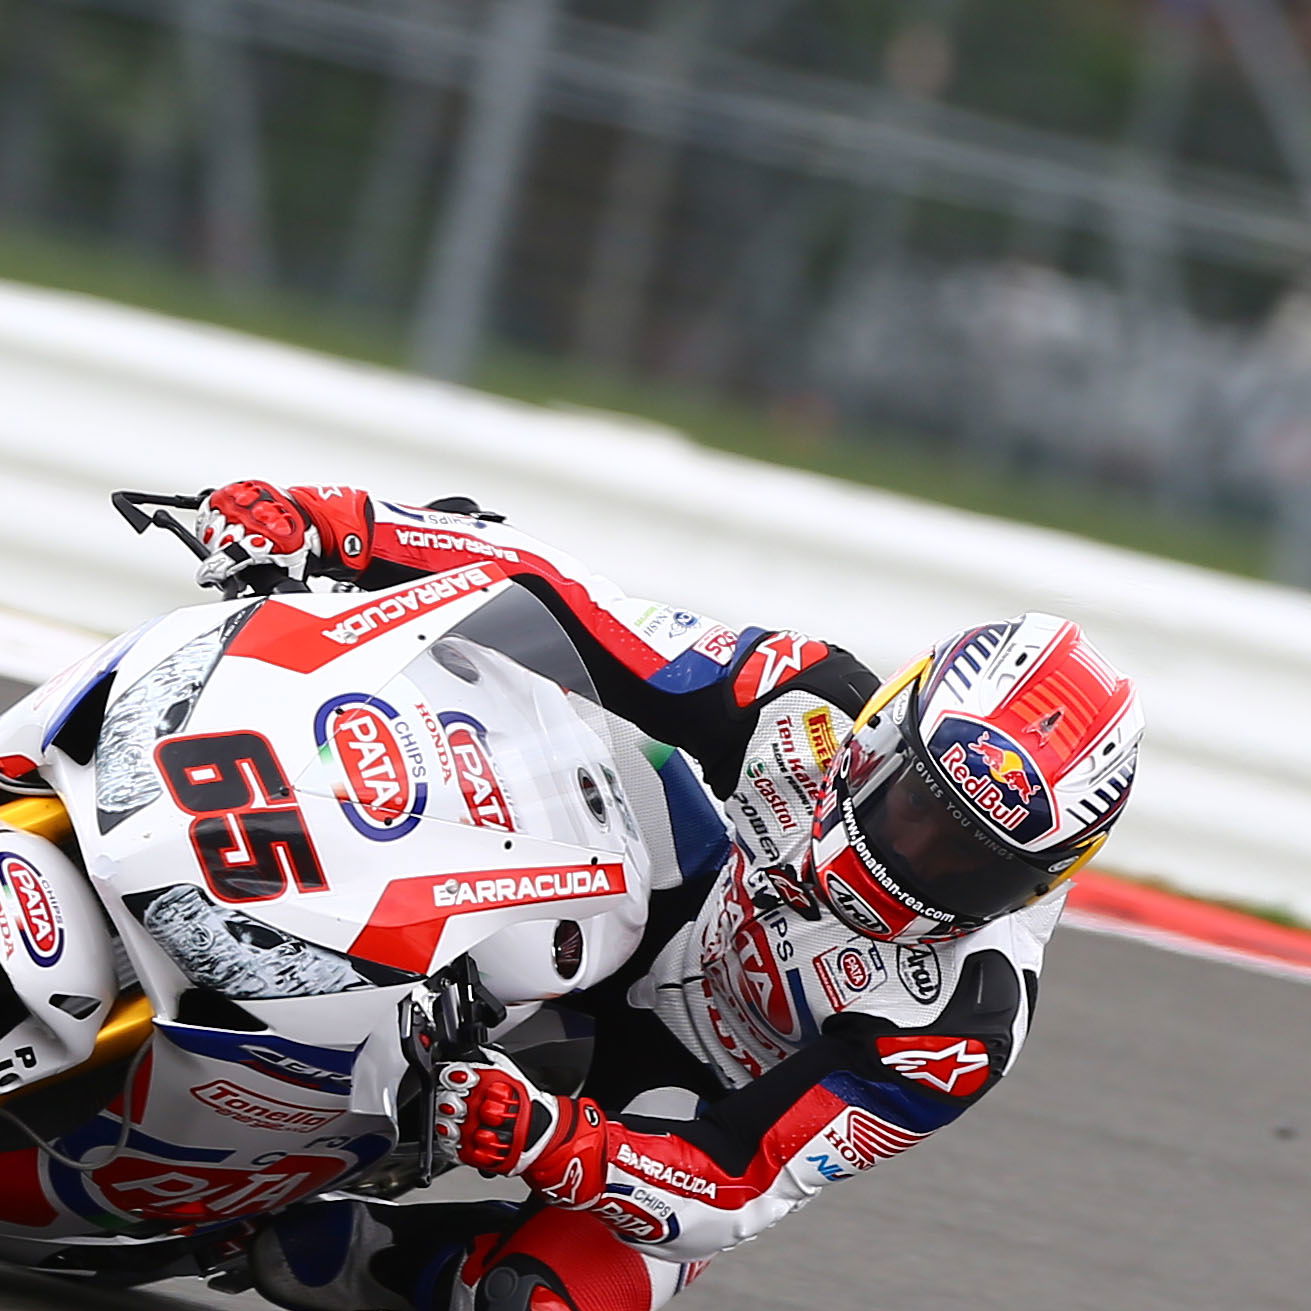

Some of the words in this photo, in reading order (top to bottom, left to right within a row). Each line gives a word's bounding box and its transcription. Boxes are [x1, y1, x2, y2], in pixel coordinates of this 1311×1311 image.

[321, 567, 493, 645] BARRACUDA
[339, 715, 402, 811] PATA
[394, 721, 427, 779] CHIPS
[414, 702, 453, 785] HONDA
[776, 715, 795, 753] Ten
[788, 758, 819, 800] Kate
[807, 713, 834, 769] PIREL
[155, 731, 329, 904] 65
[754, 778, 798, 831] Castrol
[915, 761, 944, 799] GIVES
[945, 800, 972, 828] YOU
[434, 868, 608, 907] BARRACUDA
[842, 797, 955, 923] www.jonathan-rea.com
[11, 869, 53, 942] PATA
[40, 879, 64, 924] CHIPS
[829, 879, 888, 935] Arai
[844, 952, 866, 986] PATA
[901, 944, 937, 996] Arai
[208, 1086, 328, 1127] Tonello
[616, 1143, 717, 1200] BARRACUDA
[824, 1128, 876, 1171] HON
[599, 1200, 656, 1238] PATA
[633, 1188, 671, 1218] CHIPS
